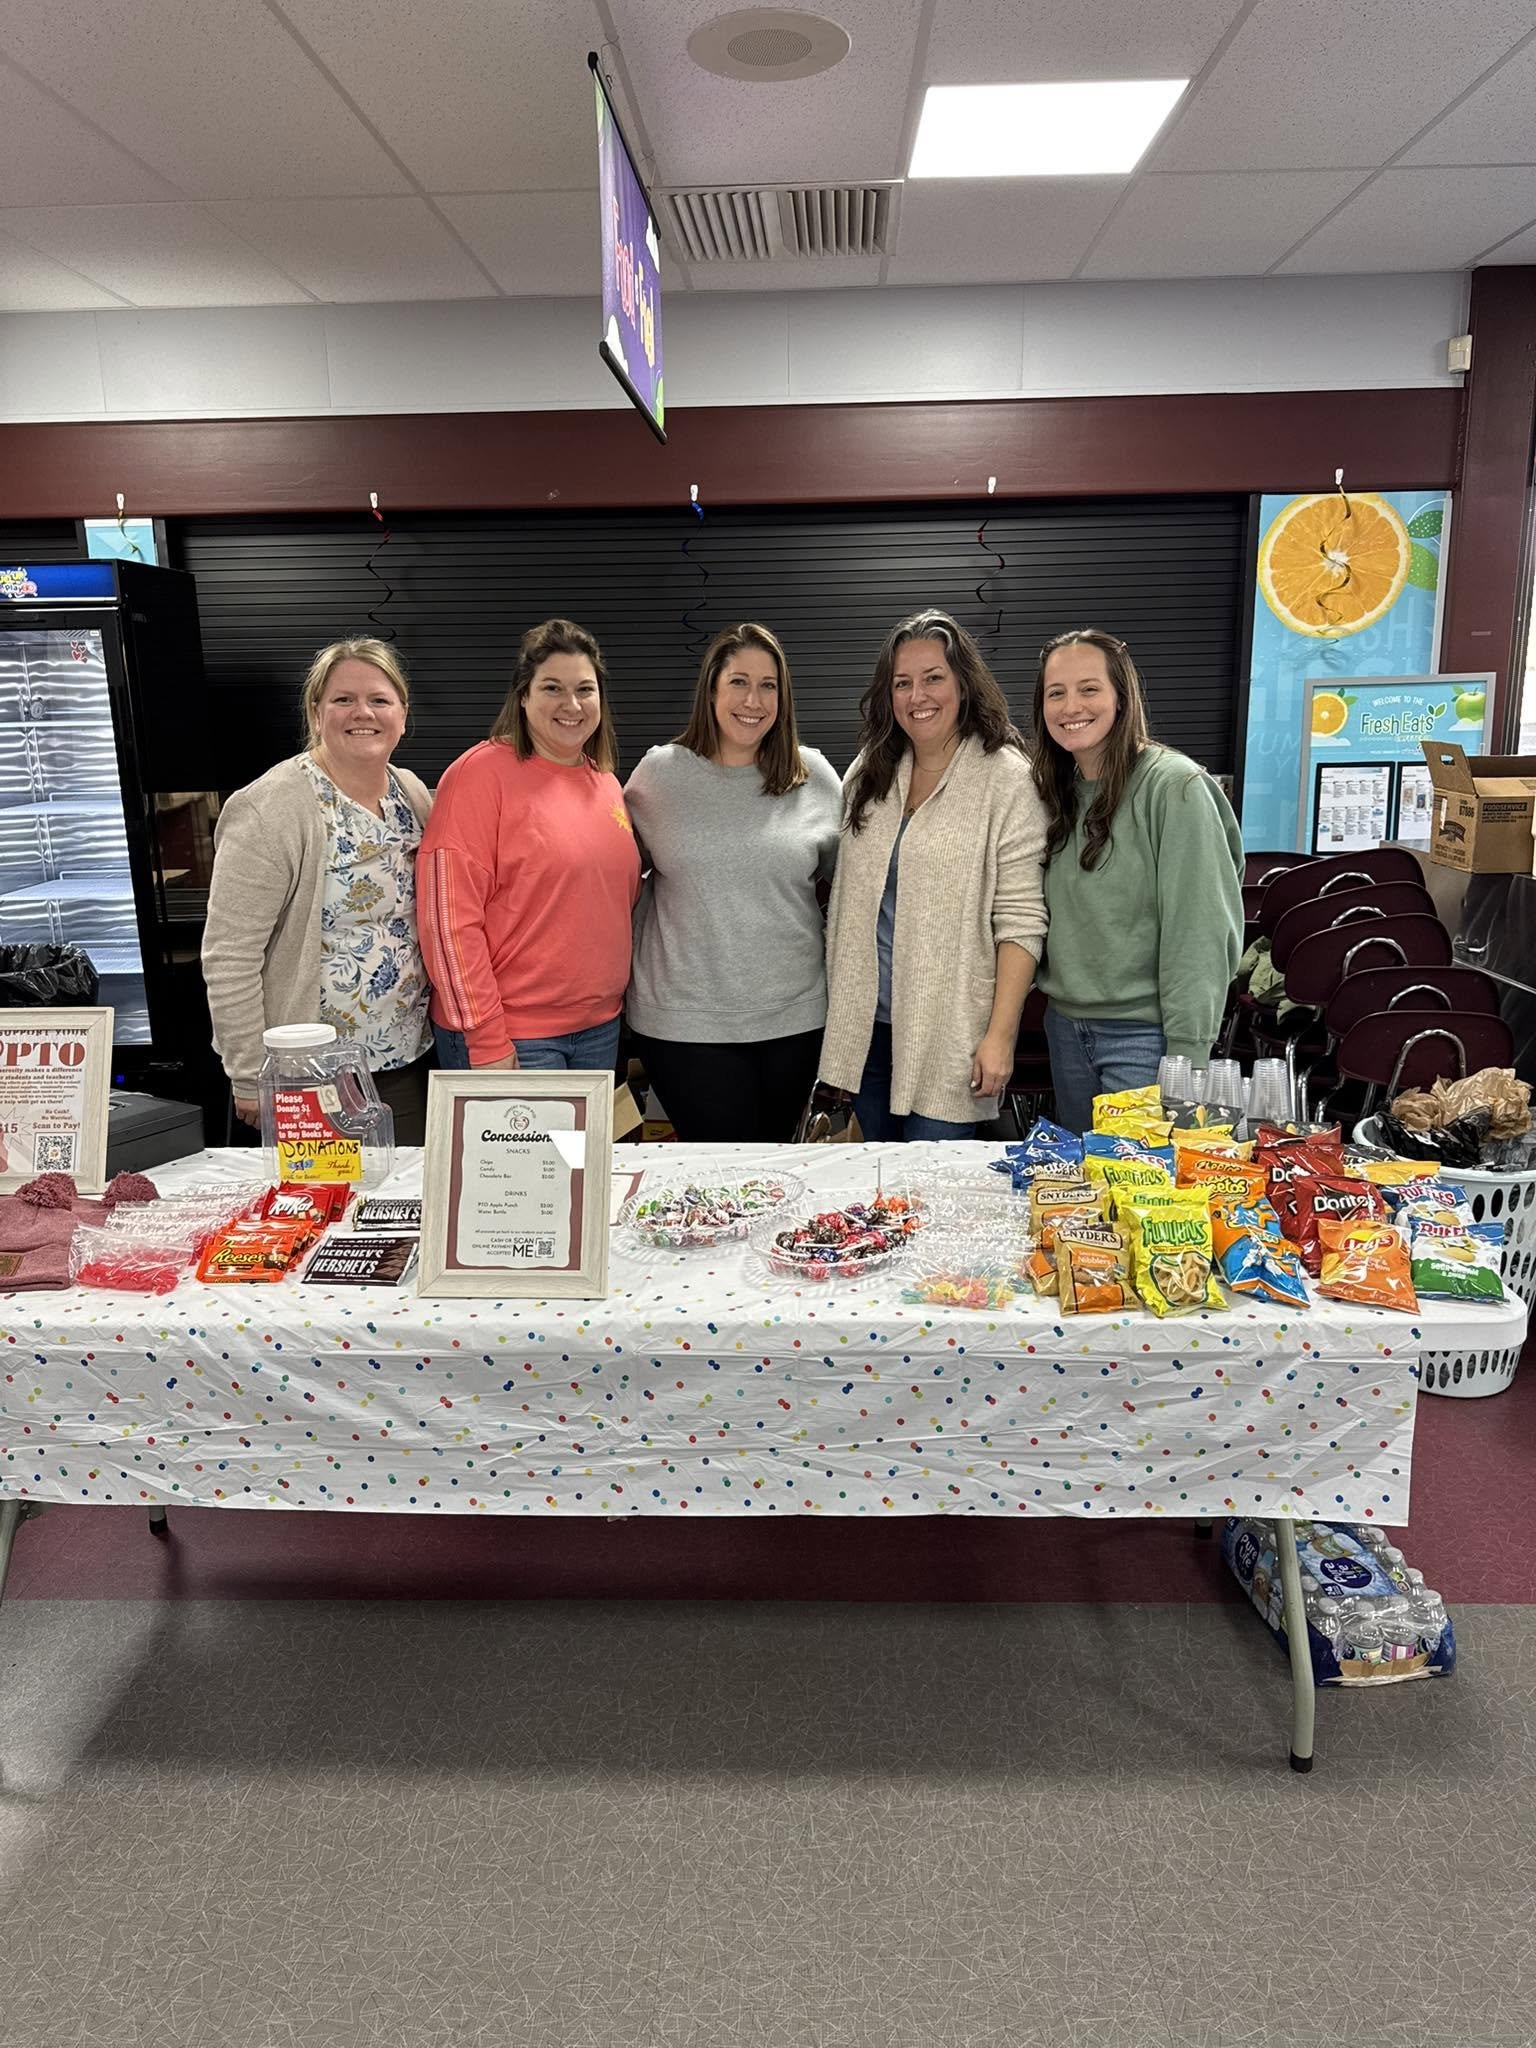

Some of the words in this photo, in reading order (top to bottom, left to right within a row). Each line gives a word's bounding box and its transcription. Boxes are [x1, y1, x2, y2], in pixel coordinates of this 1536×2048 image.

[1361, 712, 1400, 735] Fresh
[1401, 712, 1435, 734] Eats
[4, 1042, 85, 1067] PTO
[275, 1094, 303, 1104] Please
[276, 1105, 300, 1113] Donate
[301, 1104, 311, 1113] $1
[63, 1122, 80, 1130] Pay!
[278, 1122, 297, 1130] Loose
[299, 1121, 323, 1130] Change
[287, 1131, 300, 1139] Buy
[301, 1130, 322, 1138] Books
[323, 1130, 333, 1138] for
[481, 1129, 552, 1142] Concession
[279, 1140, 359, 1158] DONATIONS
[1313, 1194, 1377, 1213] Doritos
[513, 1245, 534, 1257] ME
[312, 1258, 379, 1274] HERSHEY'S
